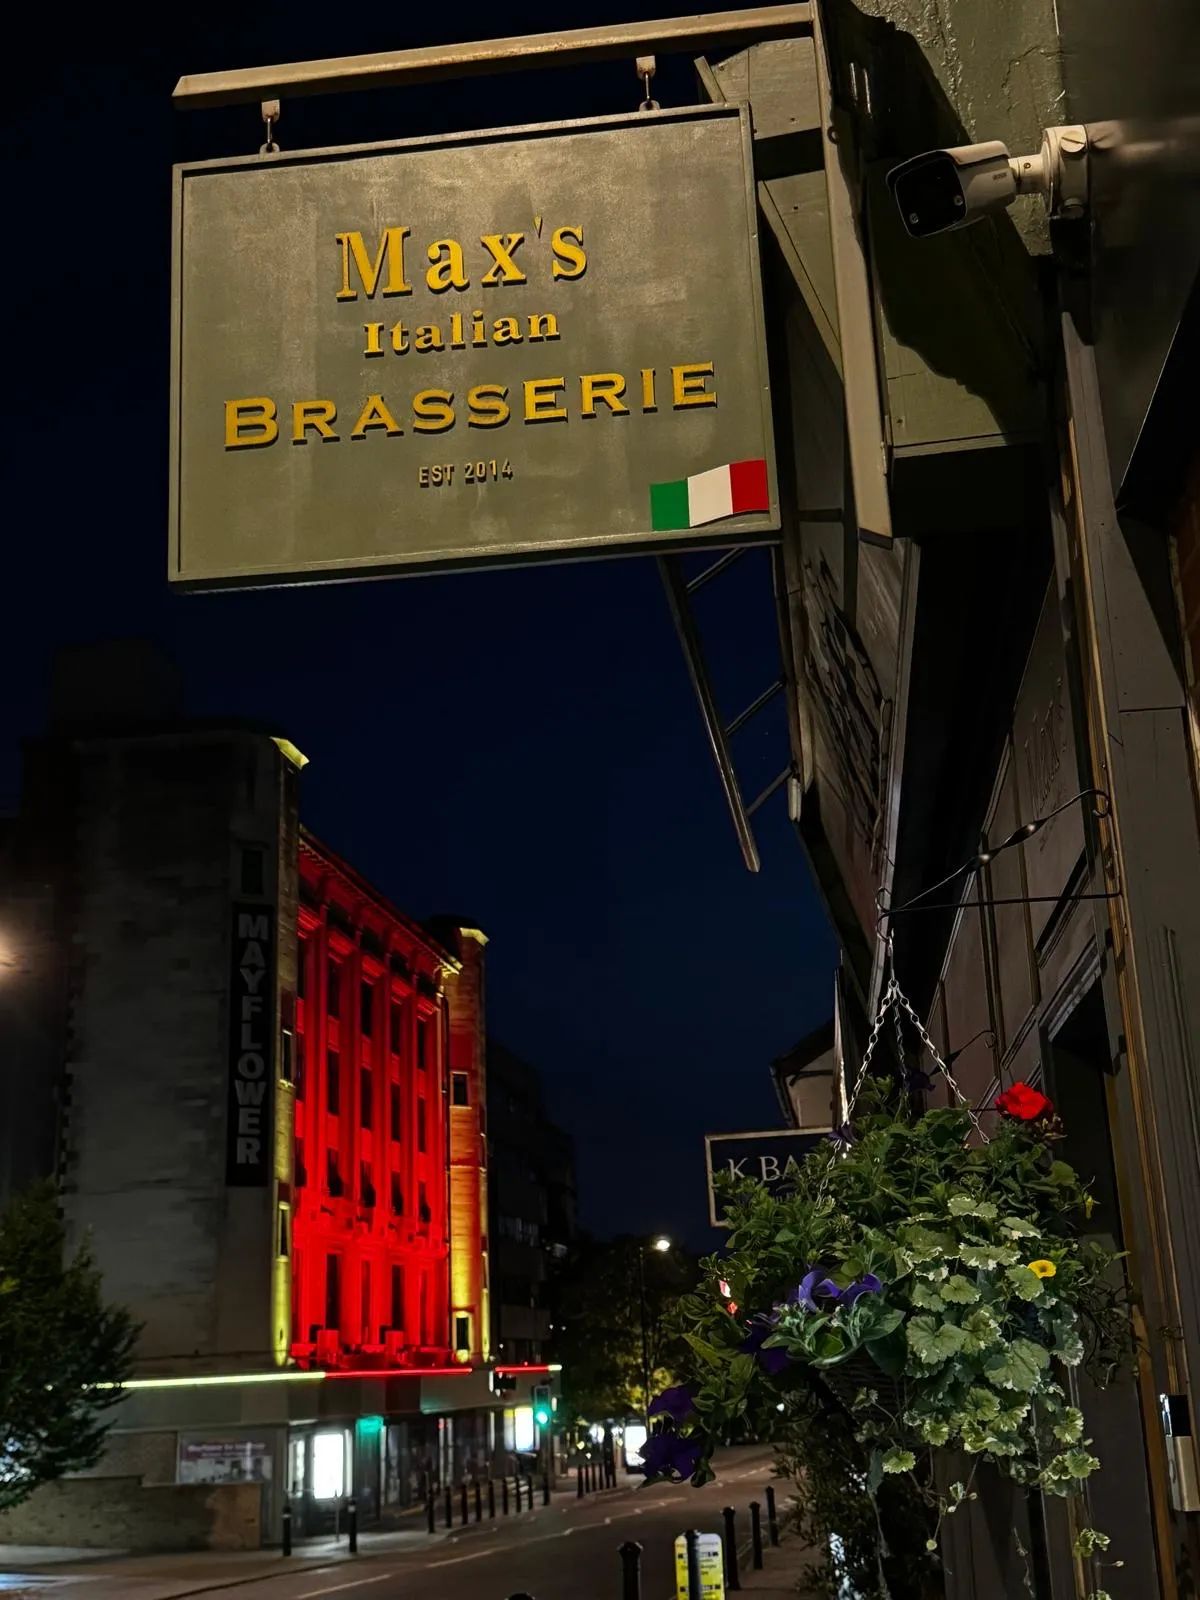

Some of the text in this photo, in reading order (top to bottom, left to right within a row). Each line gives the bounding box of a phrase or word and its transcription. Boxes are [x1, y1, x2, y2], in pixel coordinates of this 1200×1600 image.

[335, 216, 589, 301] Max's
[364, 311, 561, 357] Italian
[224, 361, 717, 450] BRASSERIE
[418, 460, 514, 487] EST 2014
[235, 914, 269, 1164] MAYFLOWER
